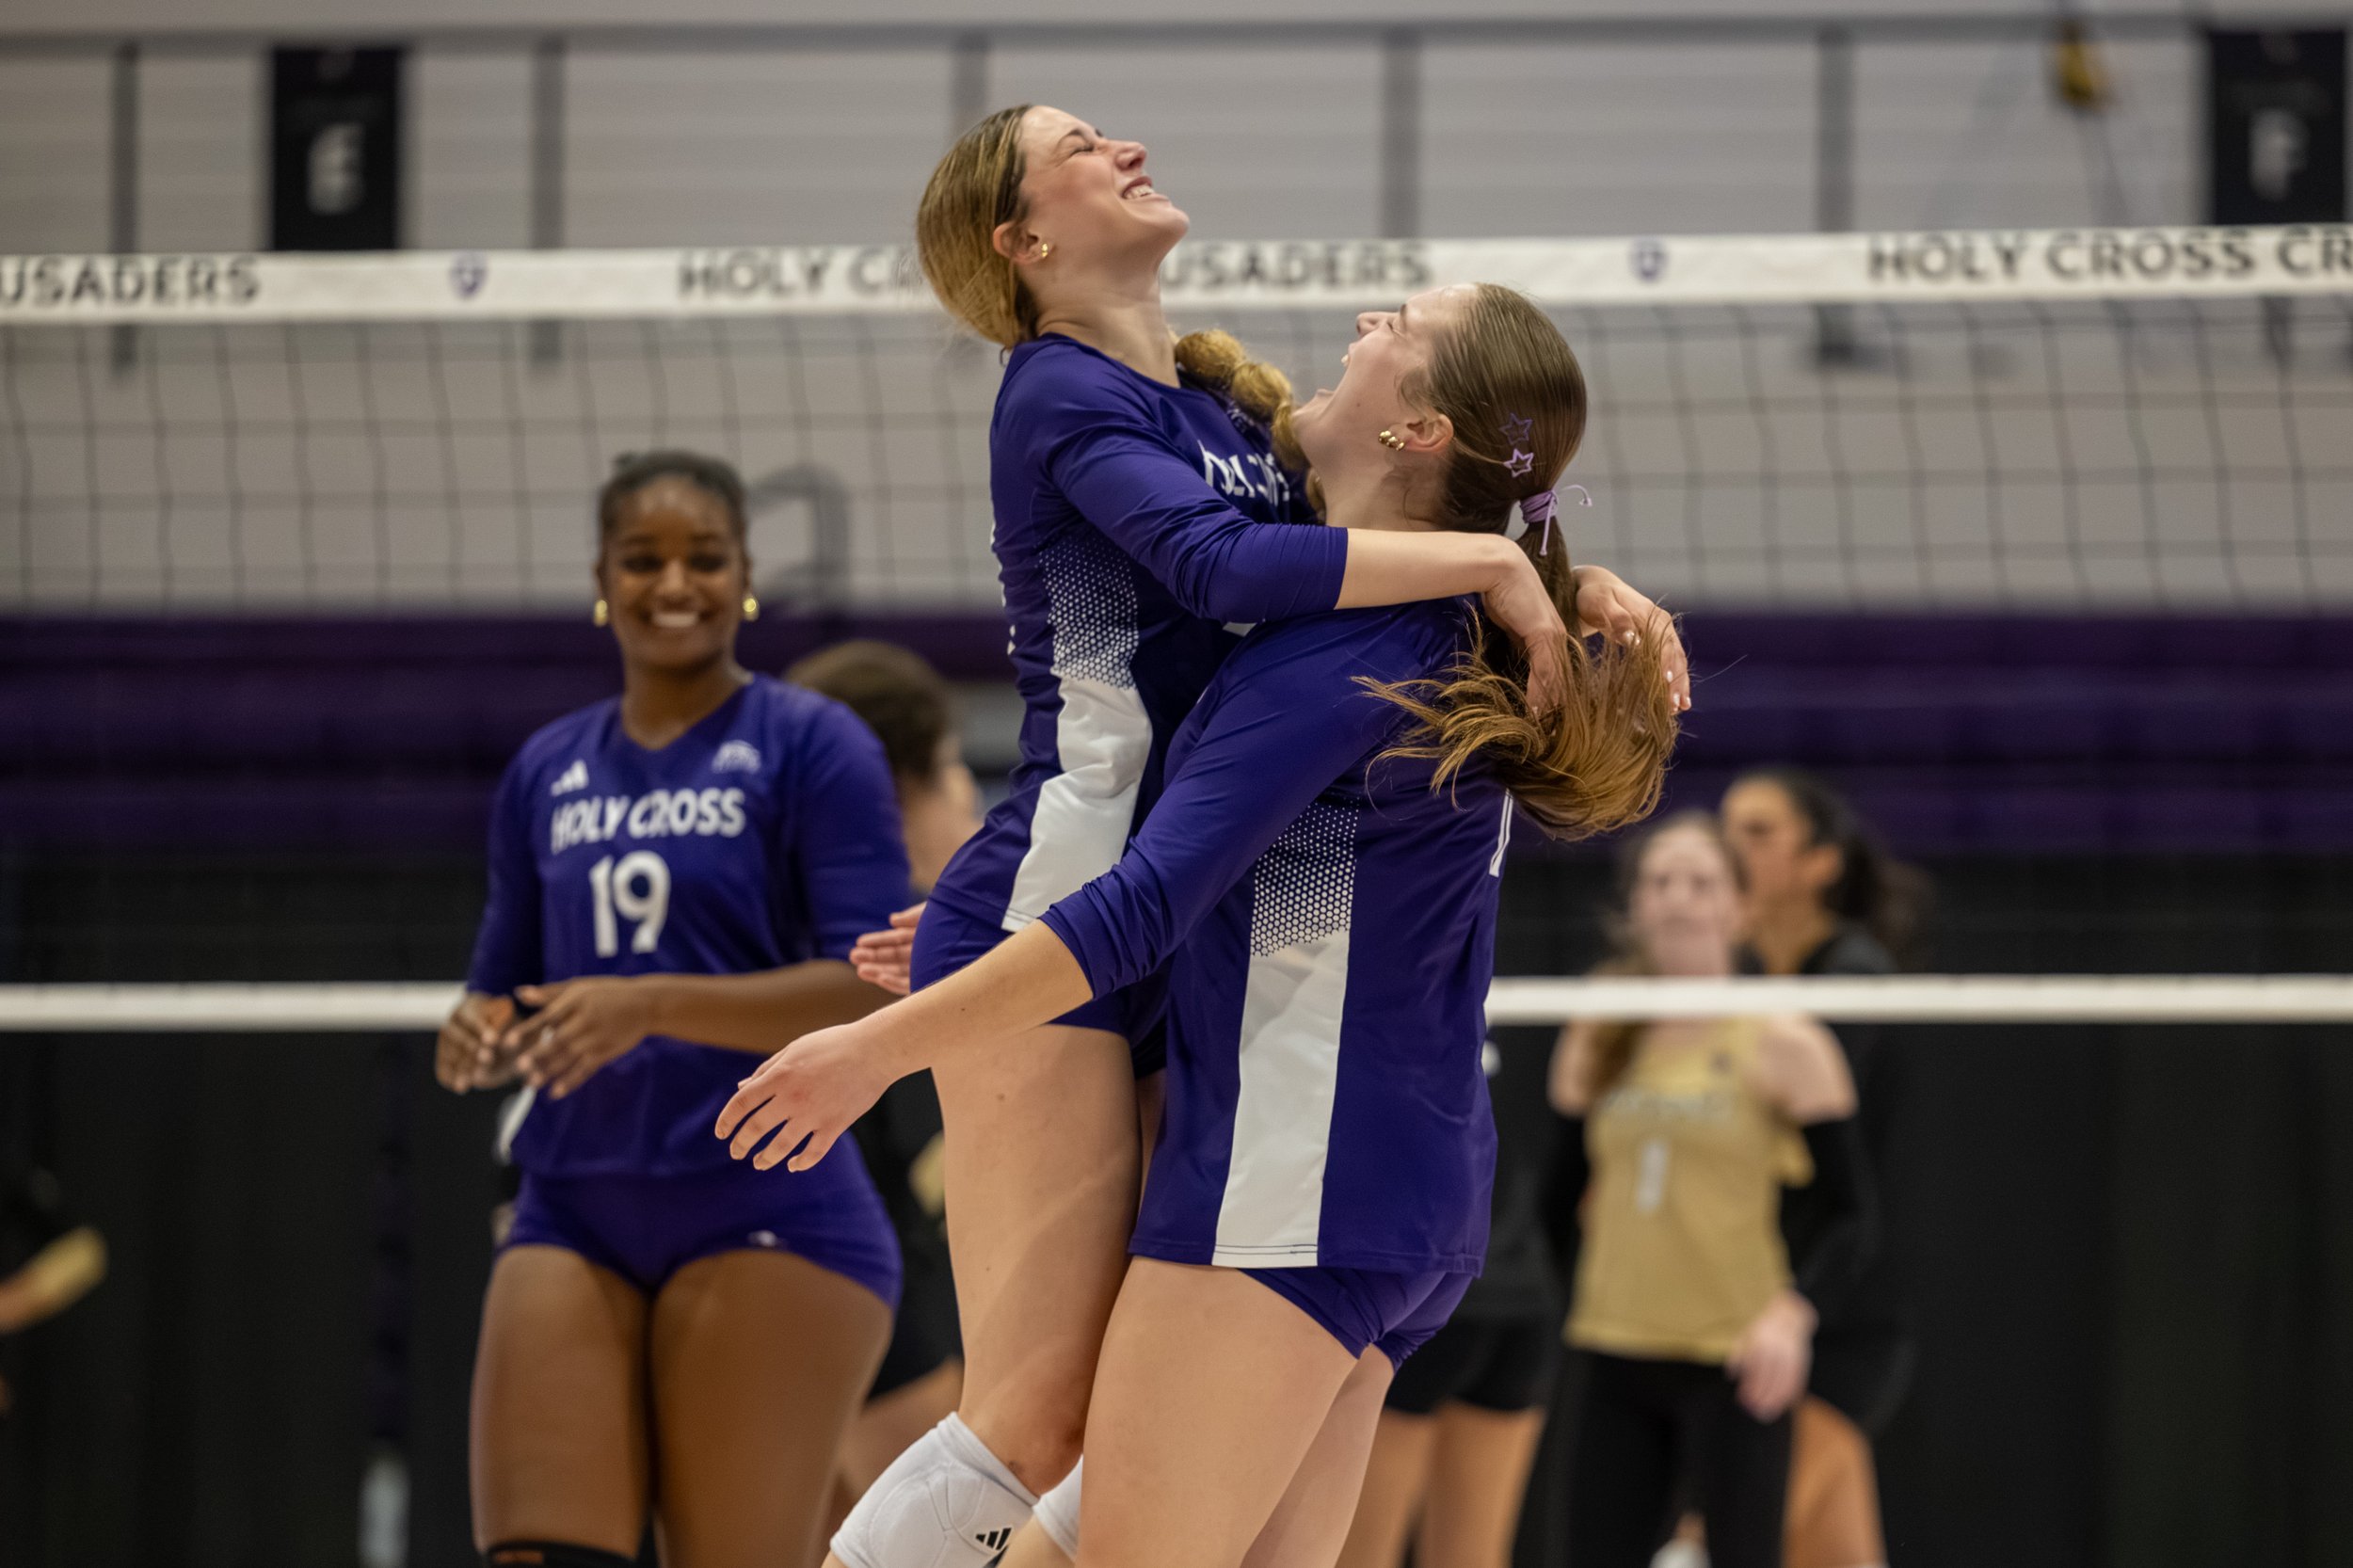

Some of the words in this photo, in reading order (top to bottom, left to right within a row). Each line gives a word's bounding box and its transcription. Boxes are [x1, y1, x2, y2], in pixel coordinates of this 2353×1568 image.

[677, 247, 830, 298] HOLY
[1867, 232, 2024, 281] HOLY
[2044, 229, 2257, 279] CROSS
[551, 796, 628, 854] HOLY
[628, 788, 746, 838] CROSS
[589, 850, 671, 958] 19
